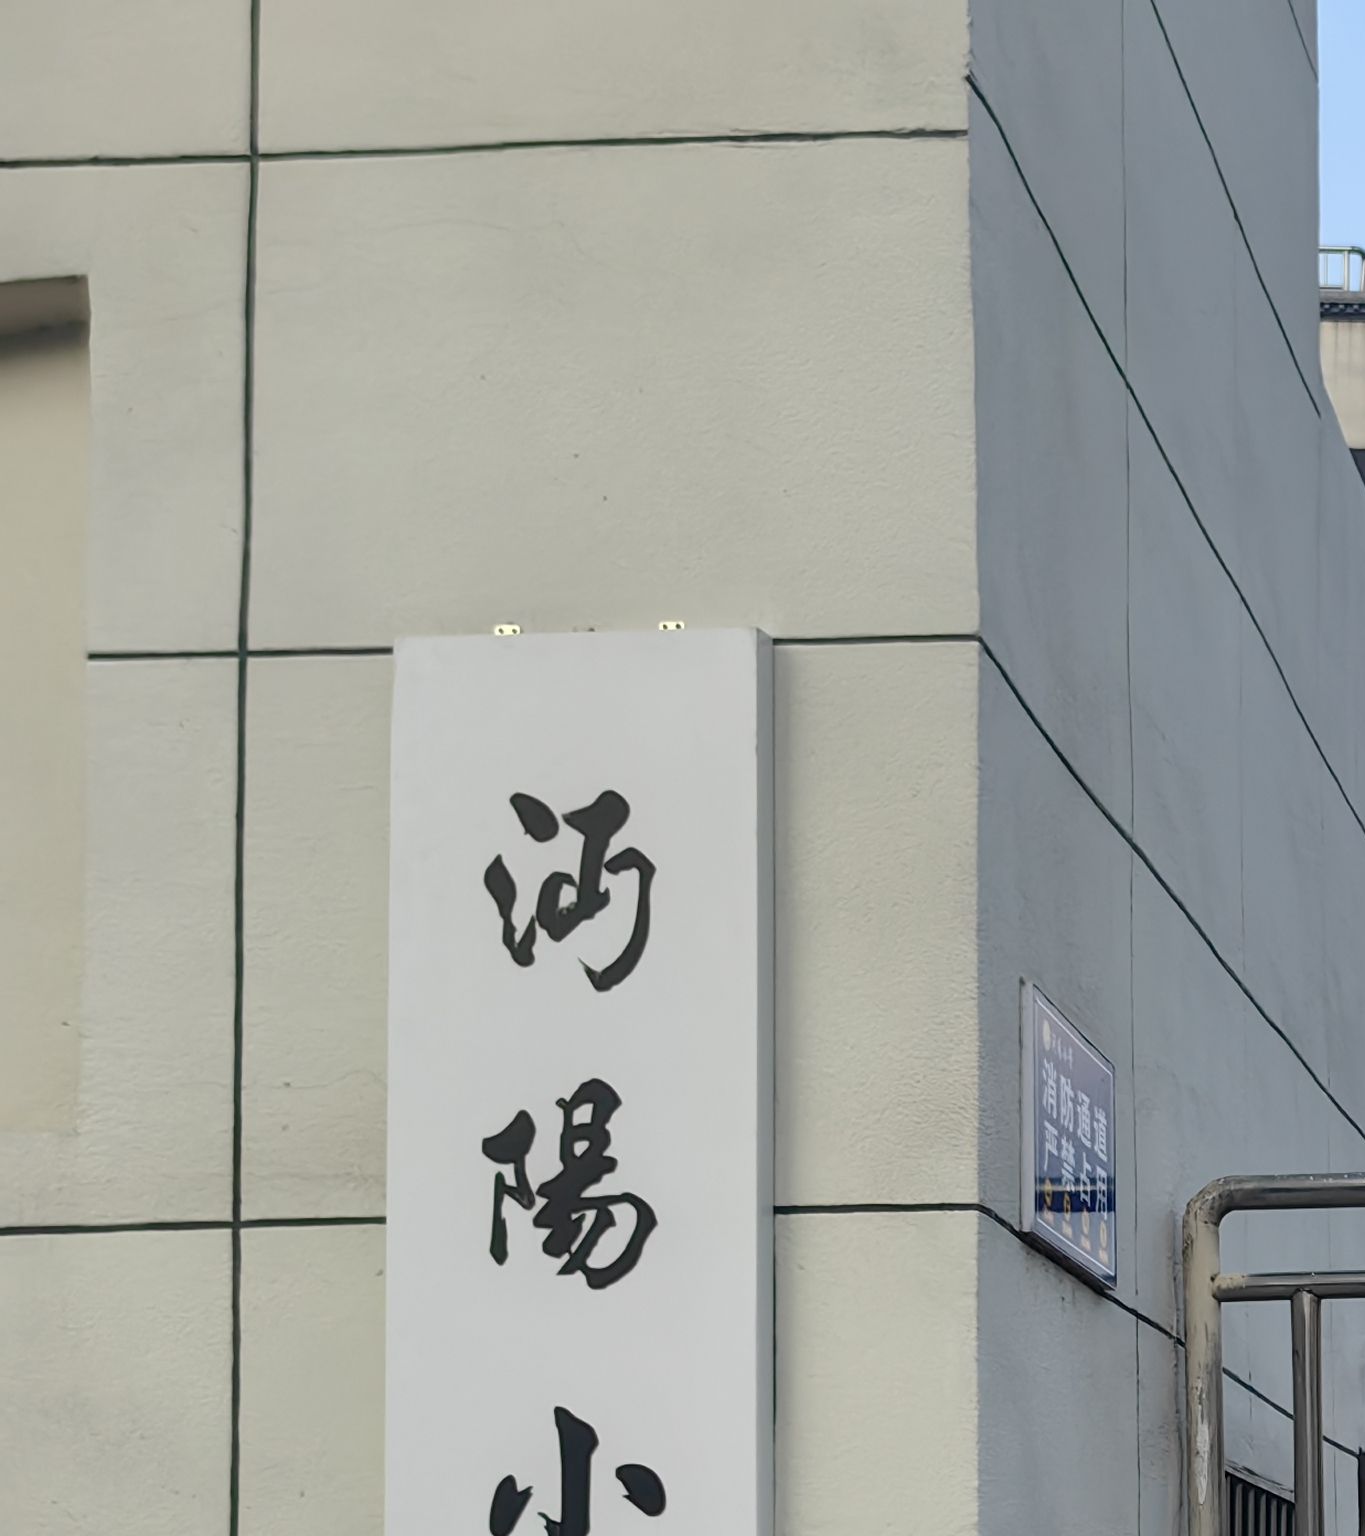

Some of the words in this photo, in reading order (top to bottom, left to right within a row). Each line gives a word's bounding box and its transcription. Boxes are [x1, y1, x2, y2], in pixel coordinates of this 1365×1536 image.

[1042, 1058, 1107, 1162] 消防通道
[1044, 1120, 1107, 1220] 严禁占用
